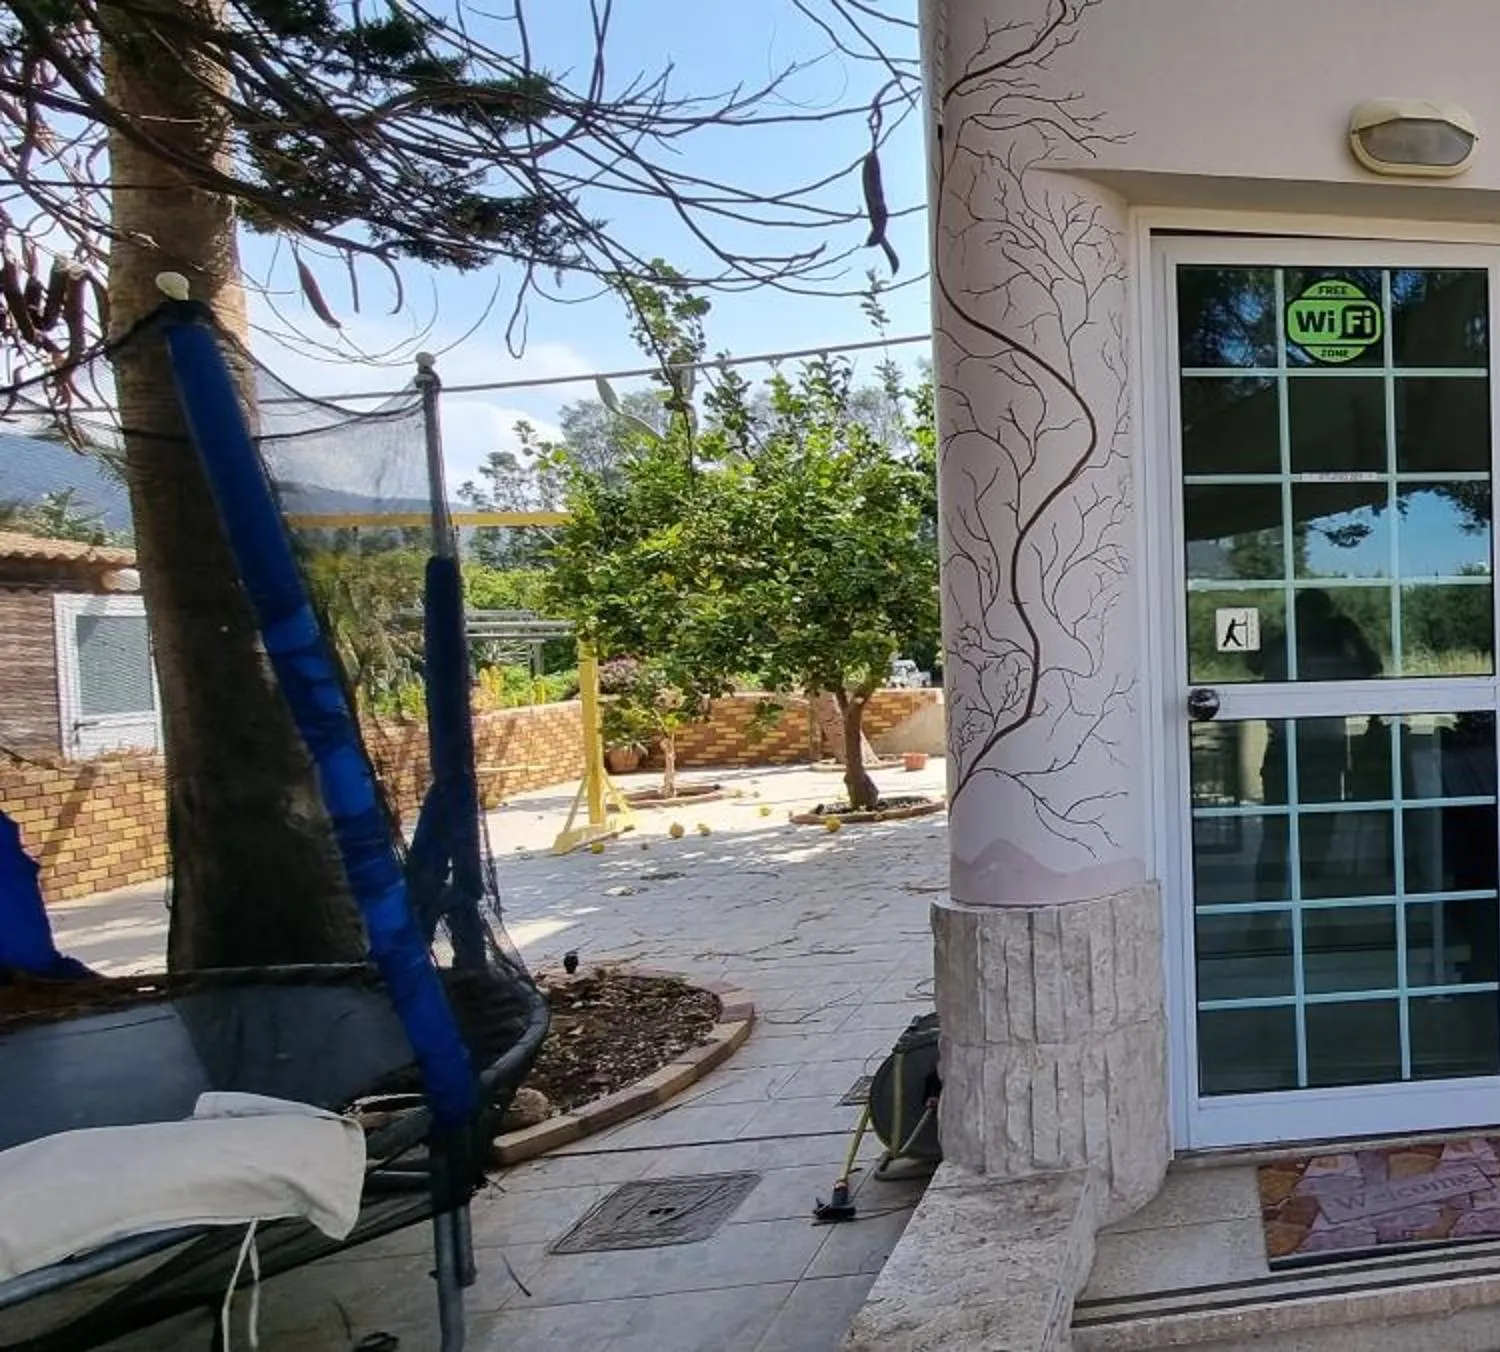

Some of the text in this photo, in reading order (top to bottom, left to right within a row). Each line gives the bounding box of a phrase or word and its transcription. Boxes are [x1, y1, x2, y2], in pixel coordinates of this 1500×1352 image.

[1318, 285, 1348, 295] FREE
[1320, 349, 1349, 358] ZONE
[1329, 1171, 1475, 1210] Welcome
